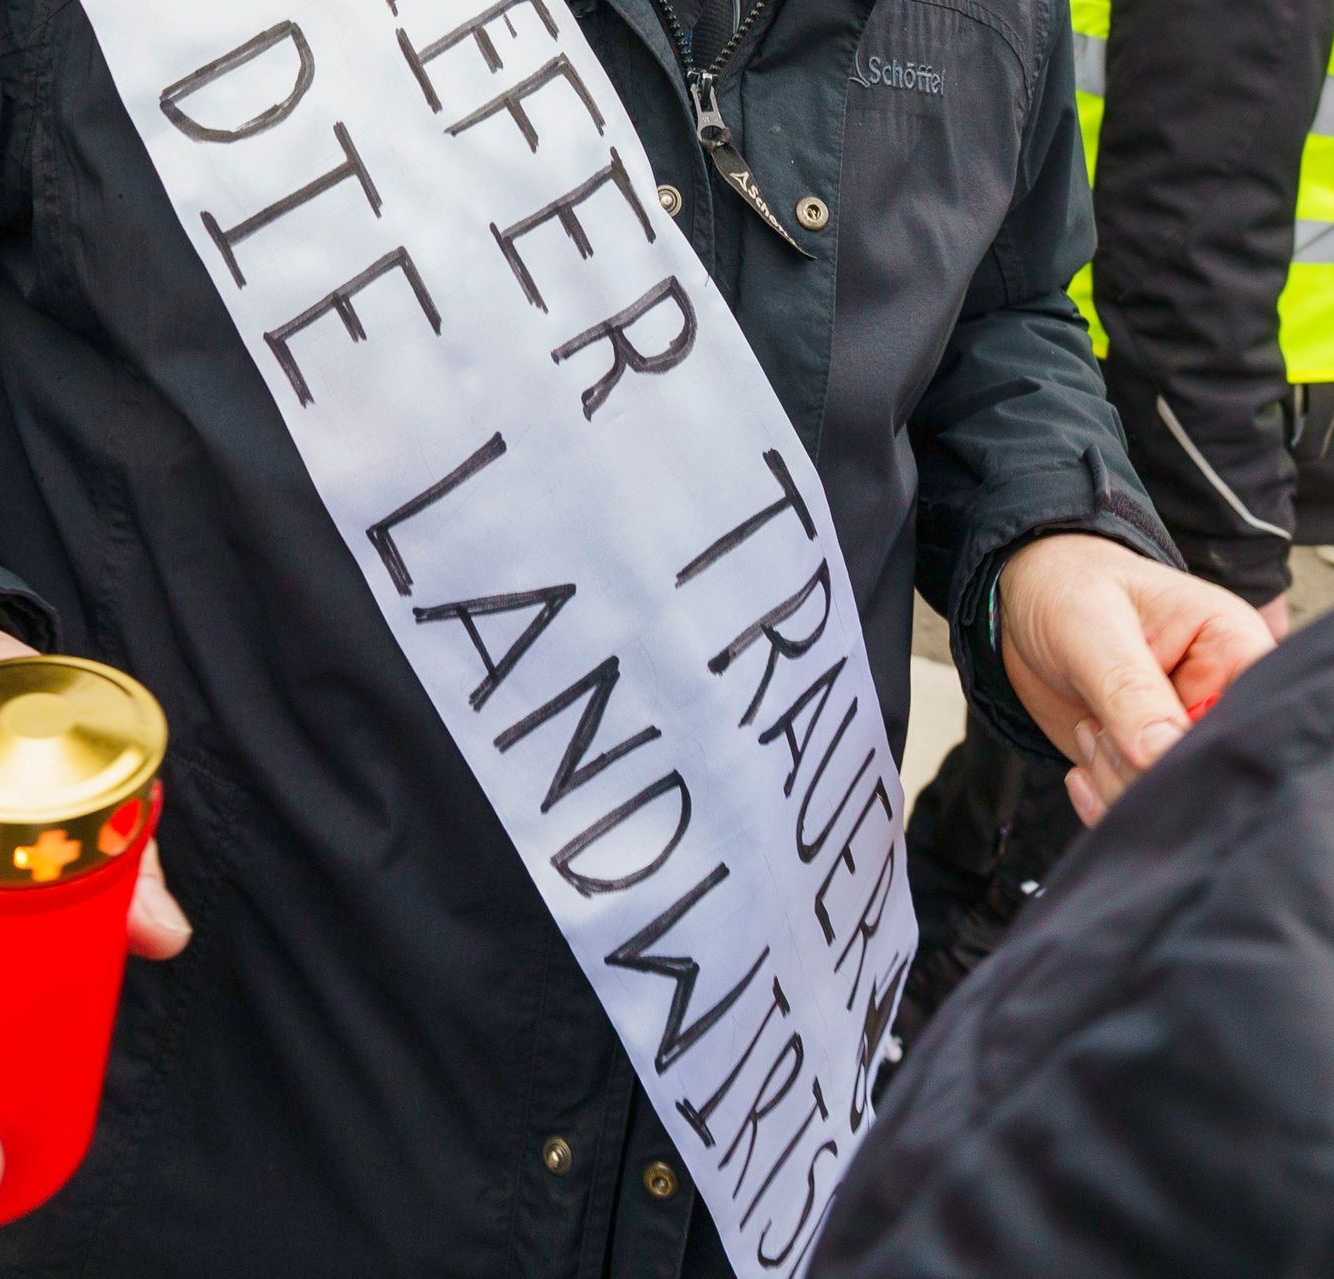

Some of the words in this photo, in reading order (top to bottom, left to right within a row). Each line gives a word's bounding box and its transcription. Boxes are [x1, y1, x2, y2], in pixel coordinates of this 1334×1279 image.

[159, 19, 443, 408] DIE
[366, 430, 841, 1279] LANDWIRTS
[675, 447, 895, 1012] TRAUER
